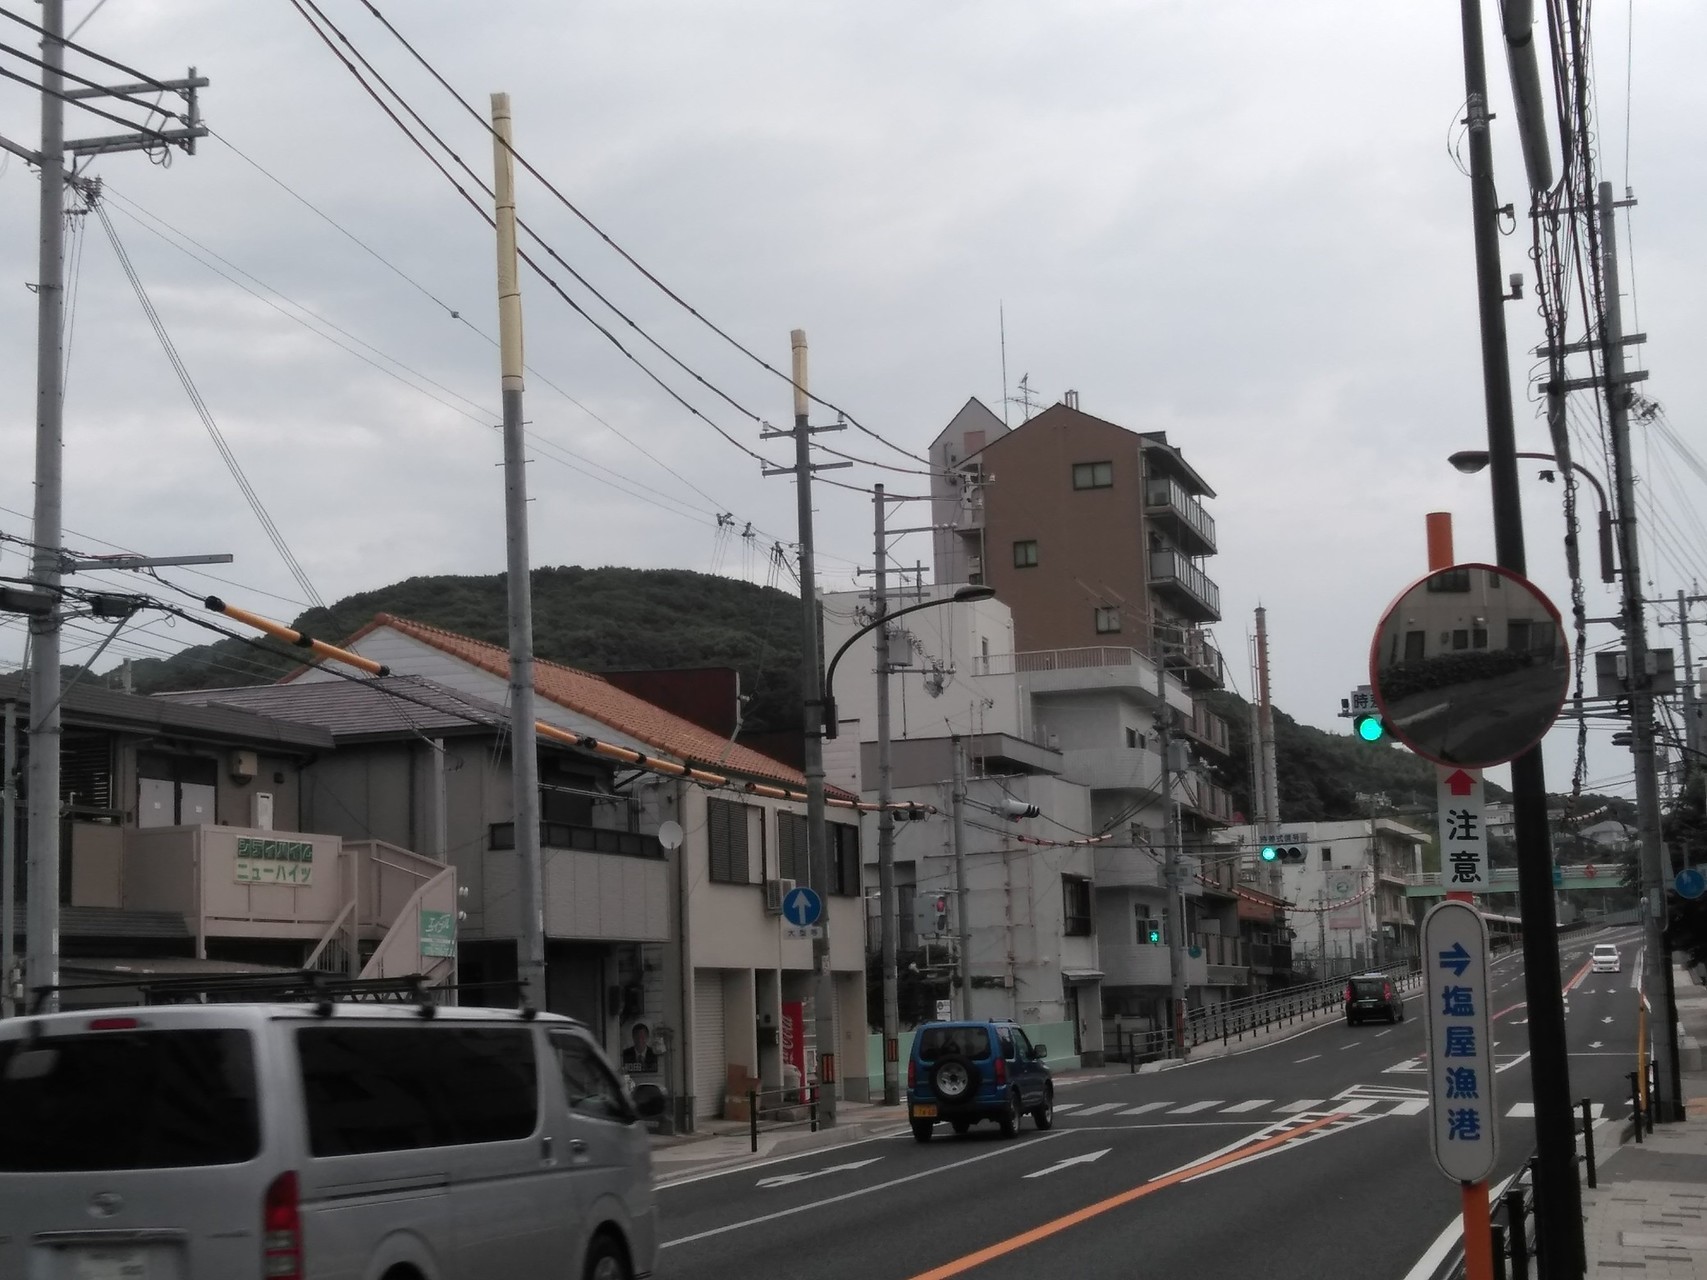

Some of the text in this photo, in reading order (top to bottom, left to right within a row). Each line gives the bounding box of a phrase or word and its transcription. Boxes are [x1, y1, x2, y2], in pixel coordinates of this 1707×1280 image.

[237, 864, 312, 882] ニューハイツ
[1446, 809, 1481, 882] 注意
[1441, 985, 1481, 1142] 塩屋漁港
